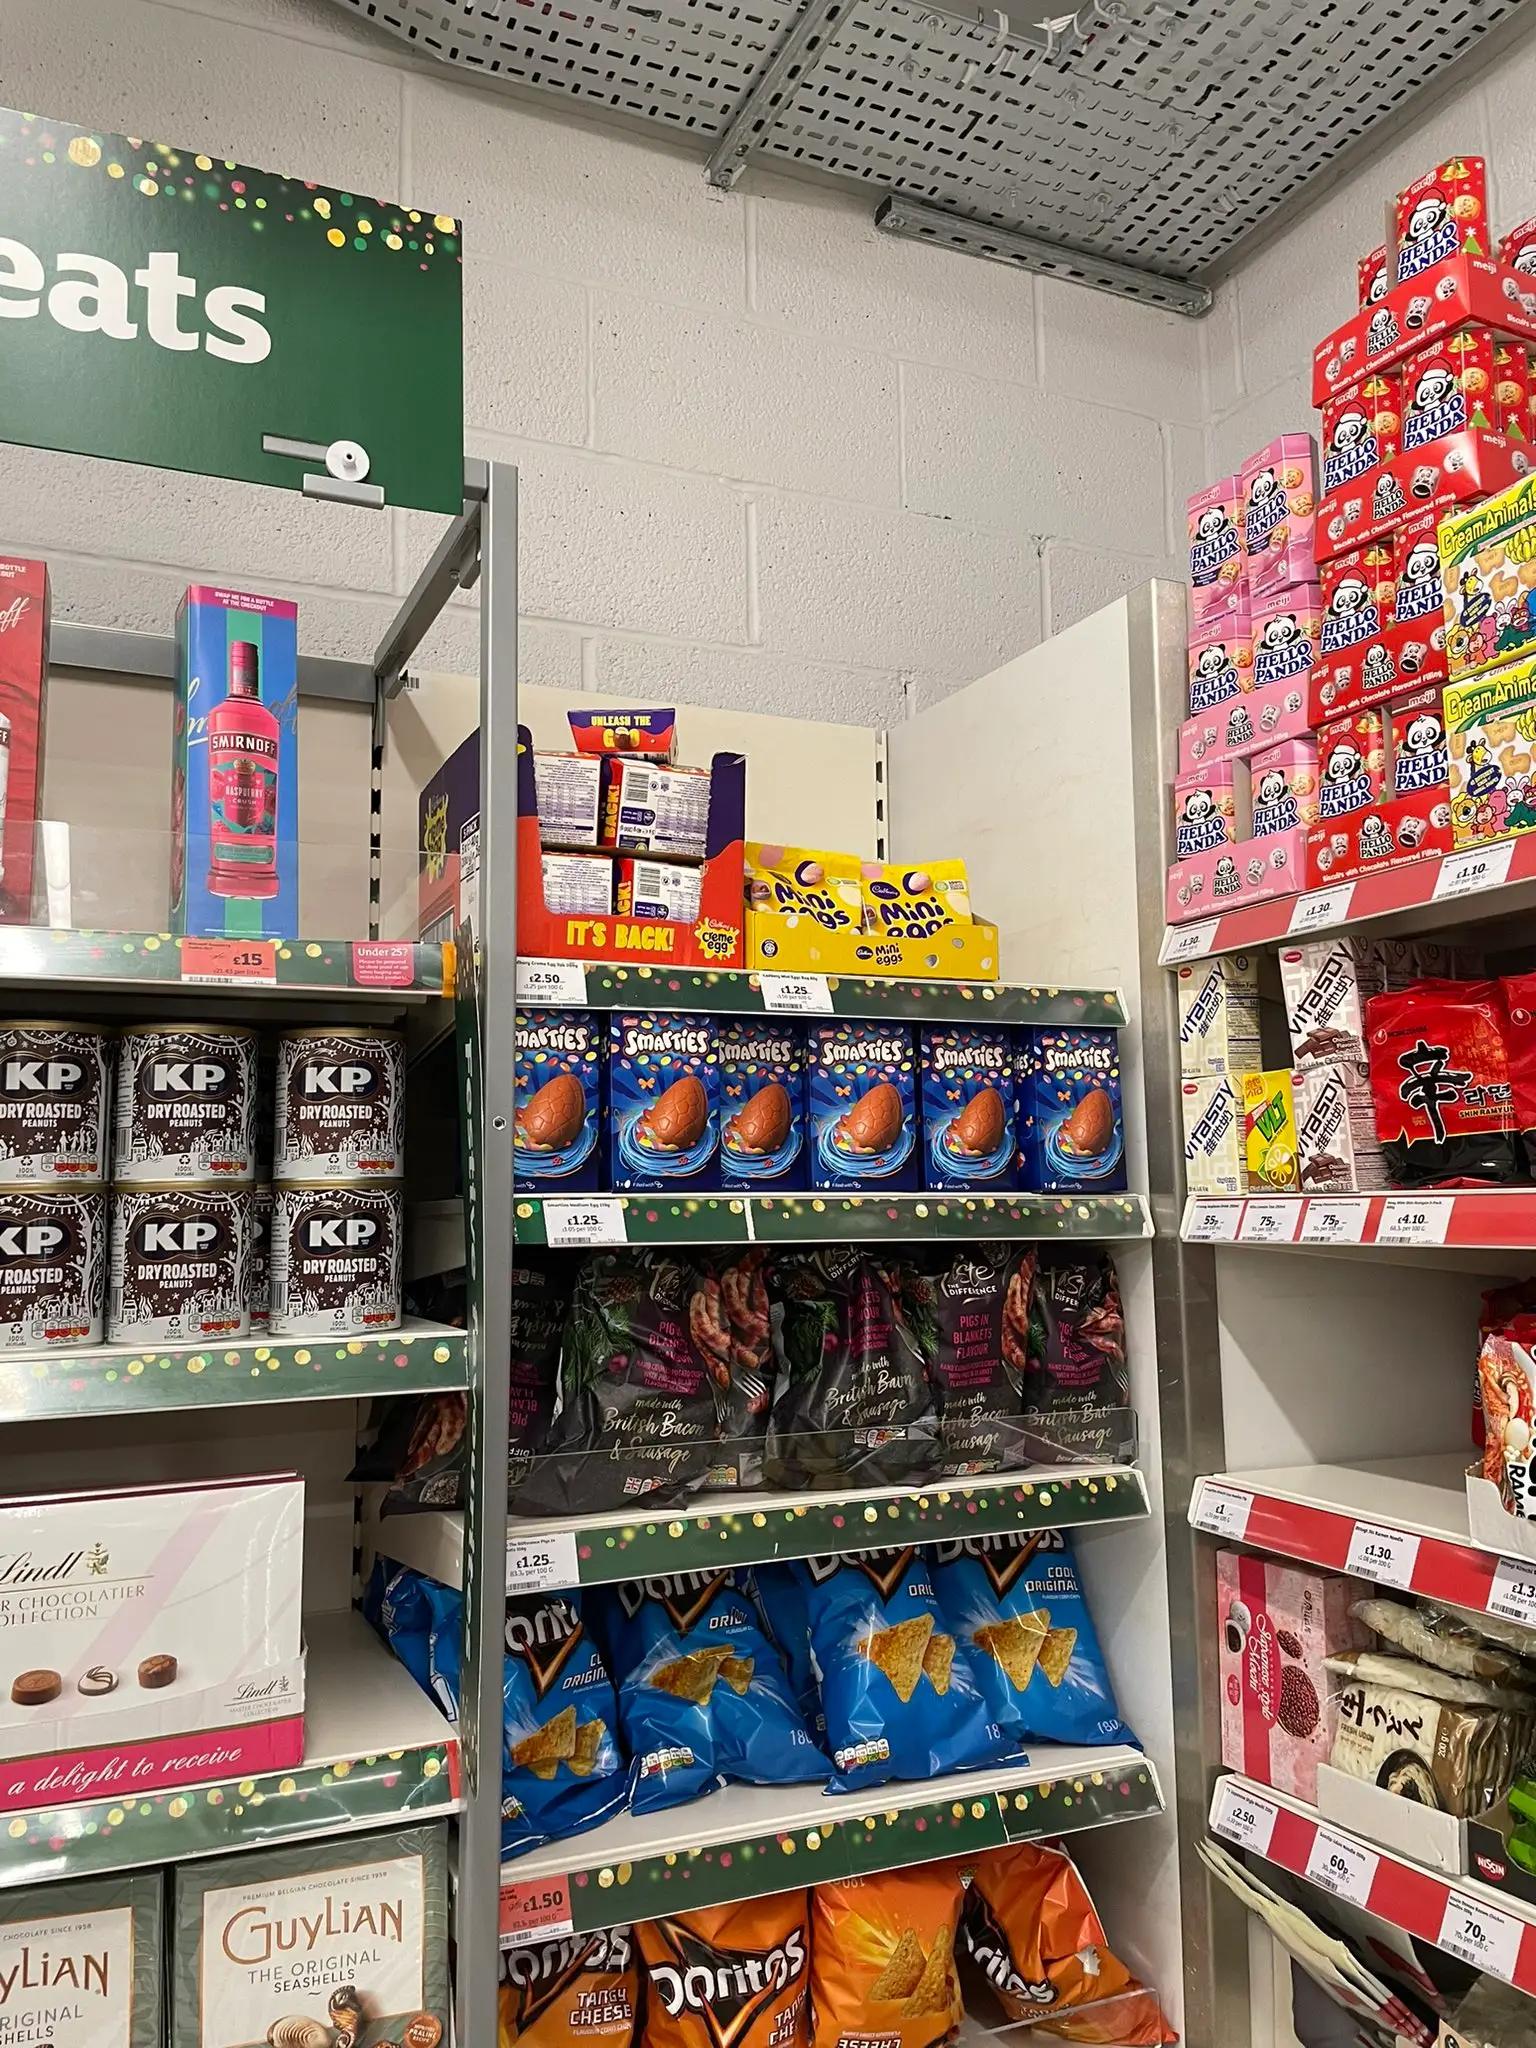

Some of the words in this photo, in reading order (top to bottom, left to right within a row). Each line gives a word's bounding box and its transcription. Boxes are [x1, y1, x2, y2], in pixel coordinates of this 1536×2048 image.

[1400, 222, 1457, 266] HELLO
[1399, 238, 1459, 283] PANDA
[1473, 259, 1497, 274] meiji
[1366, 350, 1394, 371] Chocolate
[1395, 333, 1426, 355] Flavoured
[1426, 320, 1446, 336] Filling
[1483, 433, 1507, 448] meiji
[1325, 438, 1377, 474] HELLO
[1324, 450, 1379, 490] PANDA
[1192, 529, 1236, 560] HELLO
[1192, 542, 1240, 573] PANDA
[240, 602, 267, 611] CHECKOUT
[255, 599, 274, 608] BOTTLE
[1323, 607, 1377, 638] HELLO
[1322, 619, 1380, 654] PANDA
[1255, 642, 1312, 670] HELLO
[1255, 655, 1315, 688] PANDA
[1192, 670, 1238, 697] HELLO
[1191, 683, 1240, 711] PANDA
[1408, 688, 1436, 708] meiji
[591, 716, 630, 727] UNLEASH
[634, 715, 652, 727] THE
[212, 735, 276, 754] SMIRNOFF
[604, 784, 621, 839] BACK!
[1322, 868, 1345, 882] Biscuits
[1345, 864, 1359, 876] with
[1359, 857, 1389, 874] Chocolate
[1390, 851, 1421, 867] Flavoured
[1421, 847, 1443, 860] Filling
[1457, 863, 1486, 880] £1.10
[775, 882, 836, 911] Mini
[871, 885, 900, 898] Cadbury
[880, 897, 945, 926] Mini
[1306, 902, 1331, 917] £1.30
[566, 920, 607, 948] IT'S
[615, 923, 676, 951] BACK!
[702, 932, 734, 945] creme
[1179, 936, 1199, 949] £1.30
[358, 948, 389, 957] Under
[391, 948, 409, 957] 25?
[707, 940, 728, 954] egg
[876, 943, 900, 956] Mini
[233, 953, 263, 966] £15
[876, 954, 903, 967] eggs
[529, 973, 560, 985] £2.50
[1290, 943, 1354, 1034] VITASOY
[781, 985, 808, 995] £1.25
[1180, 961, 1226, 1043] VITASOY
[624, 1027, 710, 1056] SMARTIES
[720, 1040, 791, 1064] SMARTIES
[821, 1039, 903, 1066] SMARTIES
[934, 1046, 1004, 1069] SMARTIES
[1044, 1048, 1112, 1070] SMARTIES
[5, 1062, 82, 1092] KP
[154, 1063, 226, 1092] KP
[305, 1066, 372, 1093] KP
[1398, 1039, 1474, 1145] 辛
[0, 1103, 25, 1119] DRY
[26, 1103, 82, 1119] ROASTED
[147, 1104, 172, 1120] DRY
[173, 1103, 226, 1119] ROASTED
[300, 1105, 322, 1120] DRY
[323, 1105, 373, 1120] ROASTED
[1186, 1079, 1235, 1160] VITASOY
[1254, 1090, 1288, 1143] VLT
[1298, 1068, 1346, 1159] VITASOY
[1459, 1108, 1479, 1119] SHIN
[1479, 1105, 1516, 1117] RAMYUN
[22, 1119, 57, 1128] PEANUTS
[169, 1119, 202, 1128] PEANUTS
[319, 1119, 350, 1128] PEANUTS
[567, 1215, 599, 1226] £1.25
[1203, 1215, 1219, 1227] 55p
[1260, 1216, 1275, 1228] 75p
[1322, 1215, 1339, 1227] 75p
[1398, 1214, 1425, 1225] £4.10
[144, 1222, 217, 1251] KP
[309, 1219, 376, 1248] KP
[138, 1264, 163, 1281] DRY
[163, 1262, 217, 1280] ROASTED
[303, 1259, 327, 1275] DRY
[328, 1258, 377, 1274] ROASTED
[6, 1268, 63, 1286] ROASTED
[159, 1280, 193, 1289] PEANUTS
[324, 1273, 356, 1283] PEANUTS
[1, 1284, 37, 1295] PEANUTS
[949, 1285, 998, 1296] DIFFERENCE
[959, 1314, 980, 1328] PIGS
[981, 1313, 990, 1326] IN
[952, 1328, 993, 1345] BLANKETS
[956, 1345, 989, 1359] FLAVOUR
[872, 1356, 890, 1370] with
[662, 1398, 684, 1410] with
[603, 1407, 660, 1436] British
[661, 1411, 706, 1438] Bacon
[969, 1407, 1010, 1428] Bacon
[609, 1441, 622, 1461] &
[626, 1436, 691, 1474] Sausage
[1215, 1503, 1226, 1516] £1
[516, 1554, 550, 1569] £1.25
[1365, 1545, 1392, 1560] £1.30
[0, 1551, 88, 1586] Lindt
[1048, 1566, 1075, 1579] COOL
[1026, 1580, 1078, 1594] ORIGINAL
[19, 1584, 145, 1611] CHOCOLATIER
[233, 1678, 278, 1701] Lindt
[1341, 1722, 1358, 1736] FRESH
[1358, 1726, 1375, 1744] UDON
[1438, 1739, 1448, 1758] 200
[8, 1782, 25, 1796] a
[33, 1757, 128, 1796] delight
[132, 1761, 154, 1776] to
[161, 1745, 242, 1773] receive
[1232, 1807, 1255, 1824] £2.50
[1330, 1854, 1349, 1877] 60p
[1477, 1855, 1506, 1877] NISSIN
[523, 1890, 563, 1913] £1.50
[3, 1928, 48, 1940] CHOCOLATE
[50, 1925, 72, 1935] SINCE
[221, 1895, 403, 1965] GUYLIAN
[1464, 1919, 1486, 1943] 70p
[248, 1968, 284, 1985] THE
[291, 1948, 381, 1978] ORIGINAL
[650, 1930, 805, 2016] Doritos
[274, 1968, 356, 1993] SEASHELLS
[576, 1987, 628, 2007] TANGY
[570, 2005, 632, 2025] CHEESE
[409, 2027, 437, 2040] PRALINE
